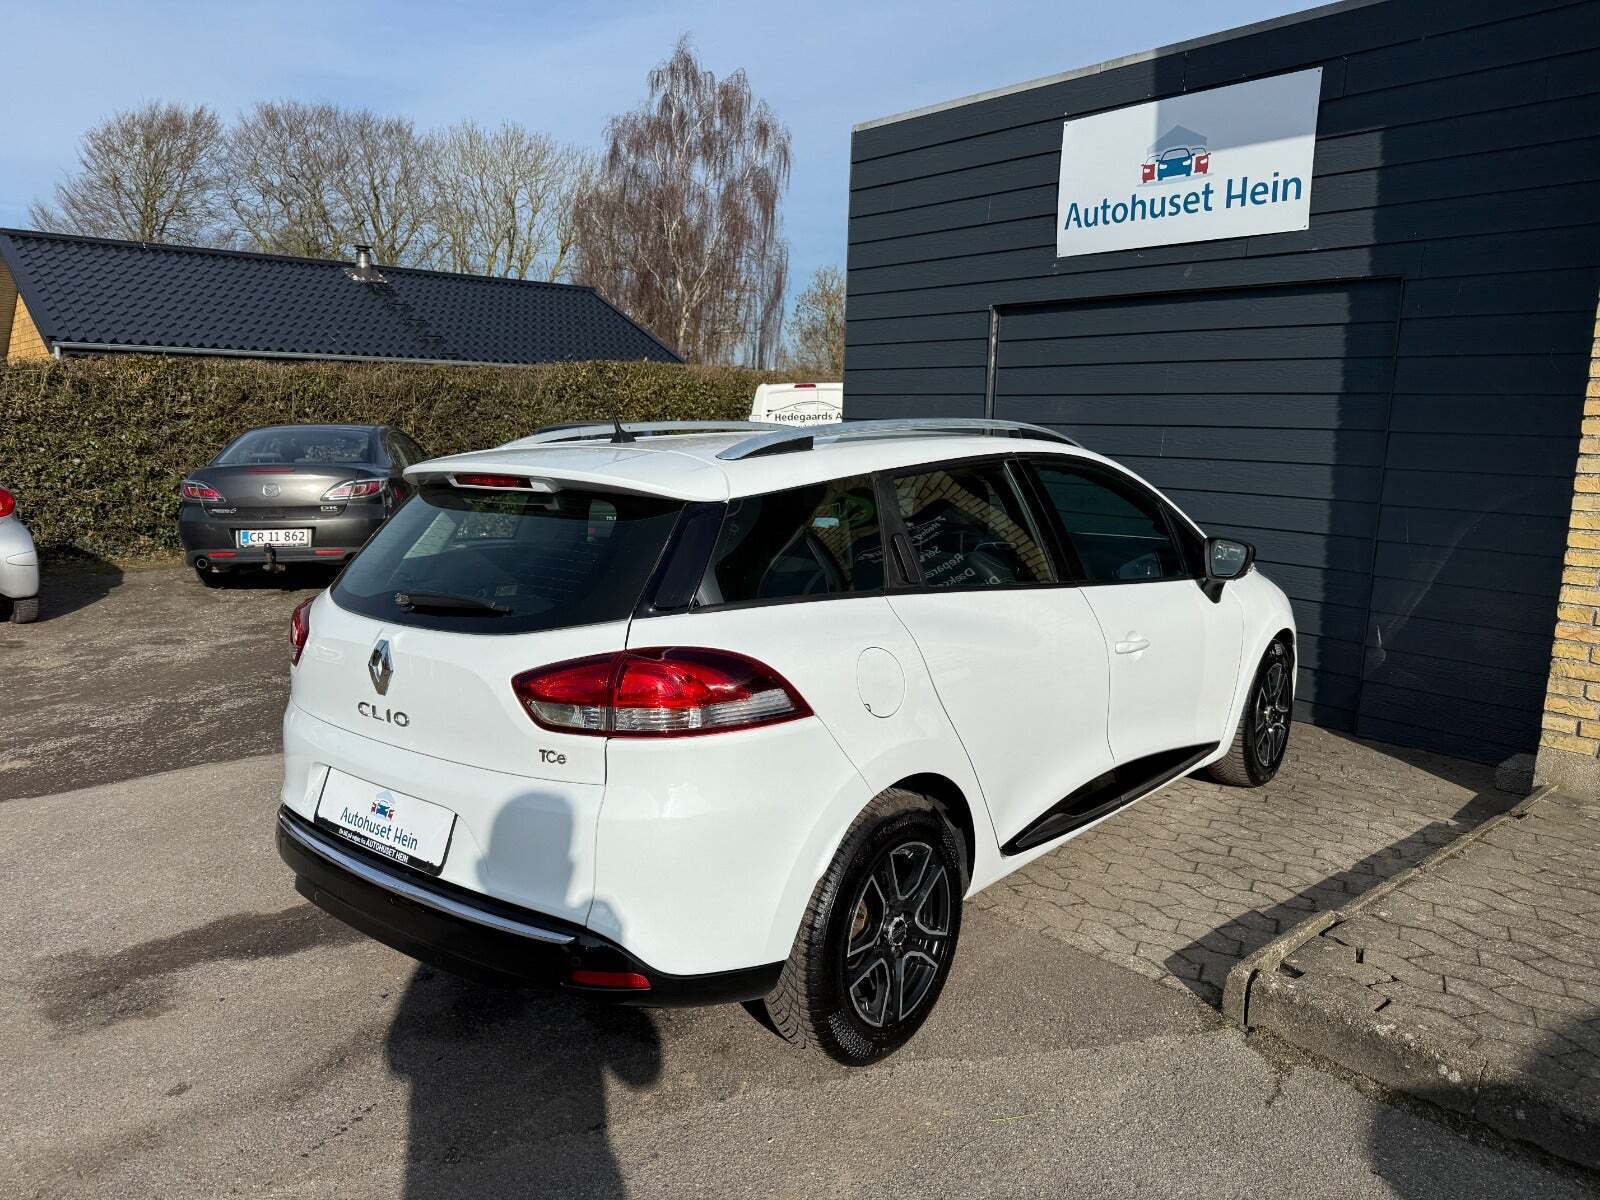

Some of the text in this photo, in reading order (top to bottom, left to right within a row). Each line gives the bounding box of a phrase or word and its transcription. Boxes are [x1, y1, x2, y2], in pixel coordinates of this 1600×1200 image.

[1064, 171, 1302, 230] Autohuset Hein
[774, 411, 833, 422] Hedegaards
[250, 531, 305, 542] CR 11 862
[357, 701, 410, 728] CLIO
[538, 749, 566, 765] TCe
[340, 806, 393, 840] Autohuset
[393, 826, 418, 851] Hein
